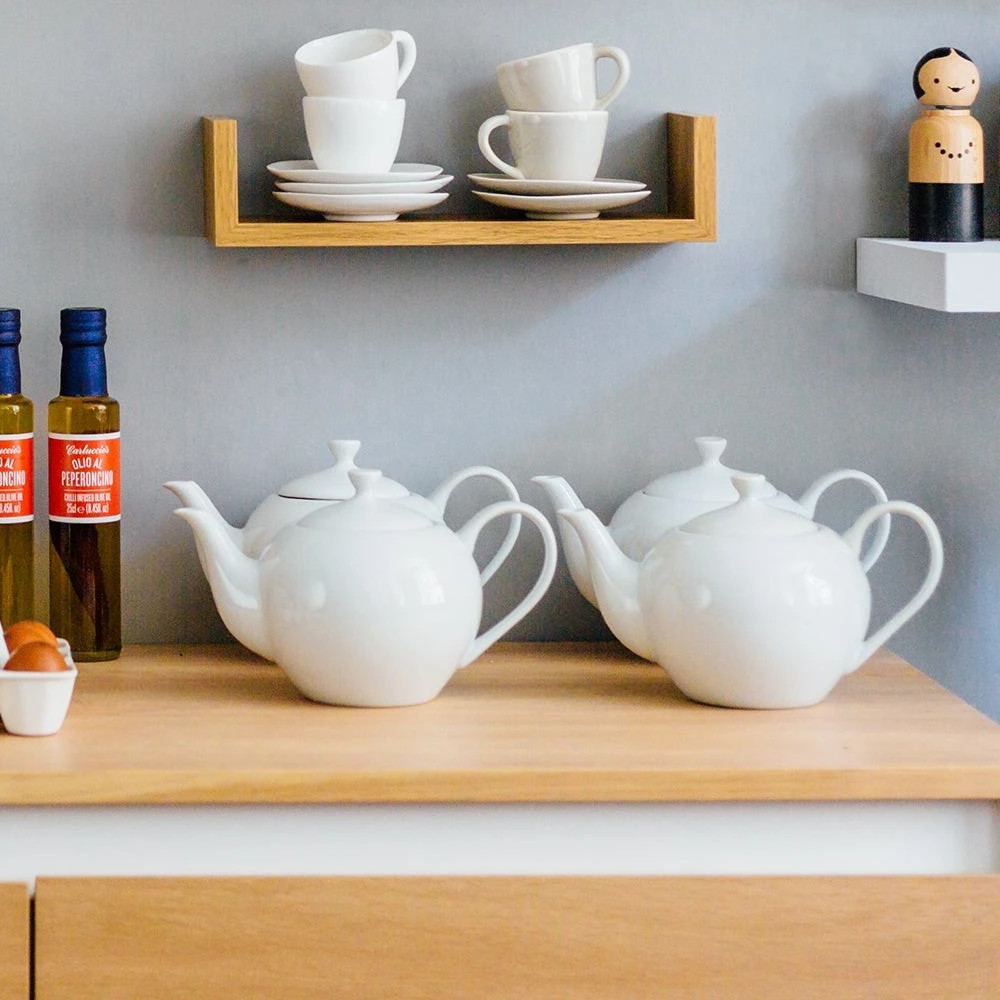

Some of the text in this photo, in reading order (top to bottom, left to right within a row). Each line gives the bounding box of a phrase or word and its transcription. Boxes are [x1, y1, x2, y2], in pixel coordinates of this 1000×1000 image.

[66, 444, 110, 455] Carluccio's
[5, 458, 15, 470] AL
[72, 457, 103, 470] OLIO AL
[61, 470, 114, 487] PEPERONCINO
